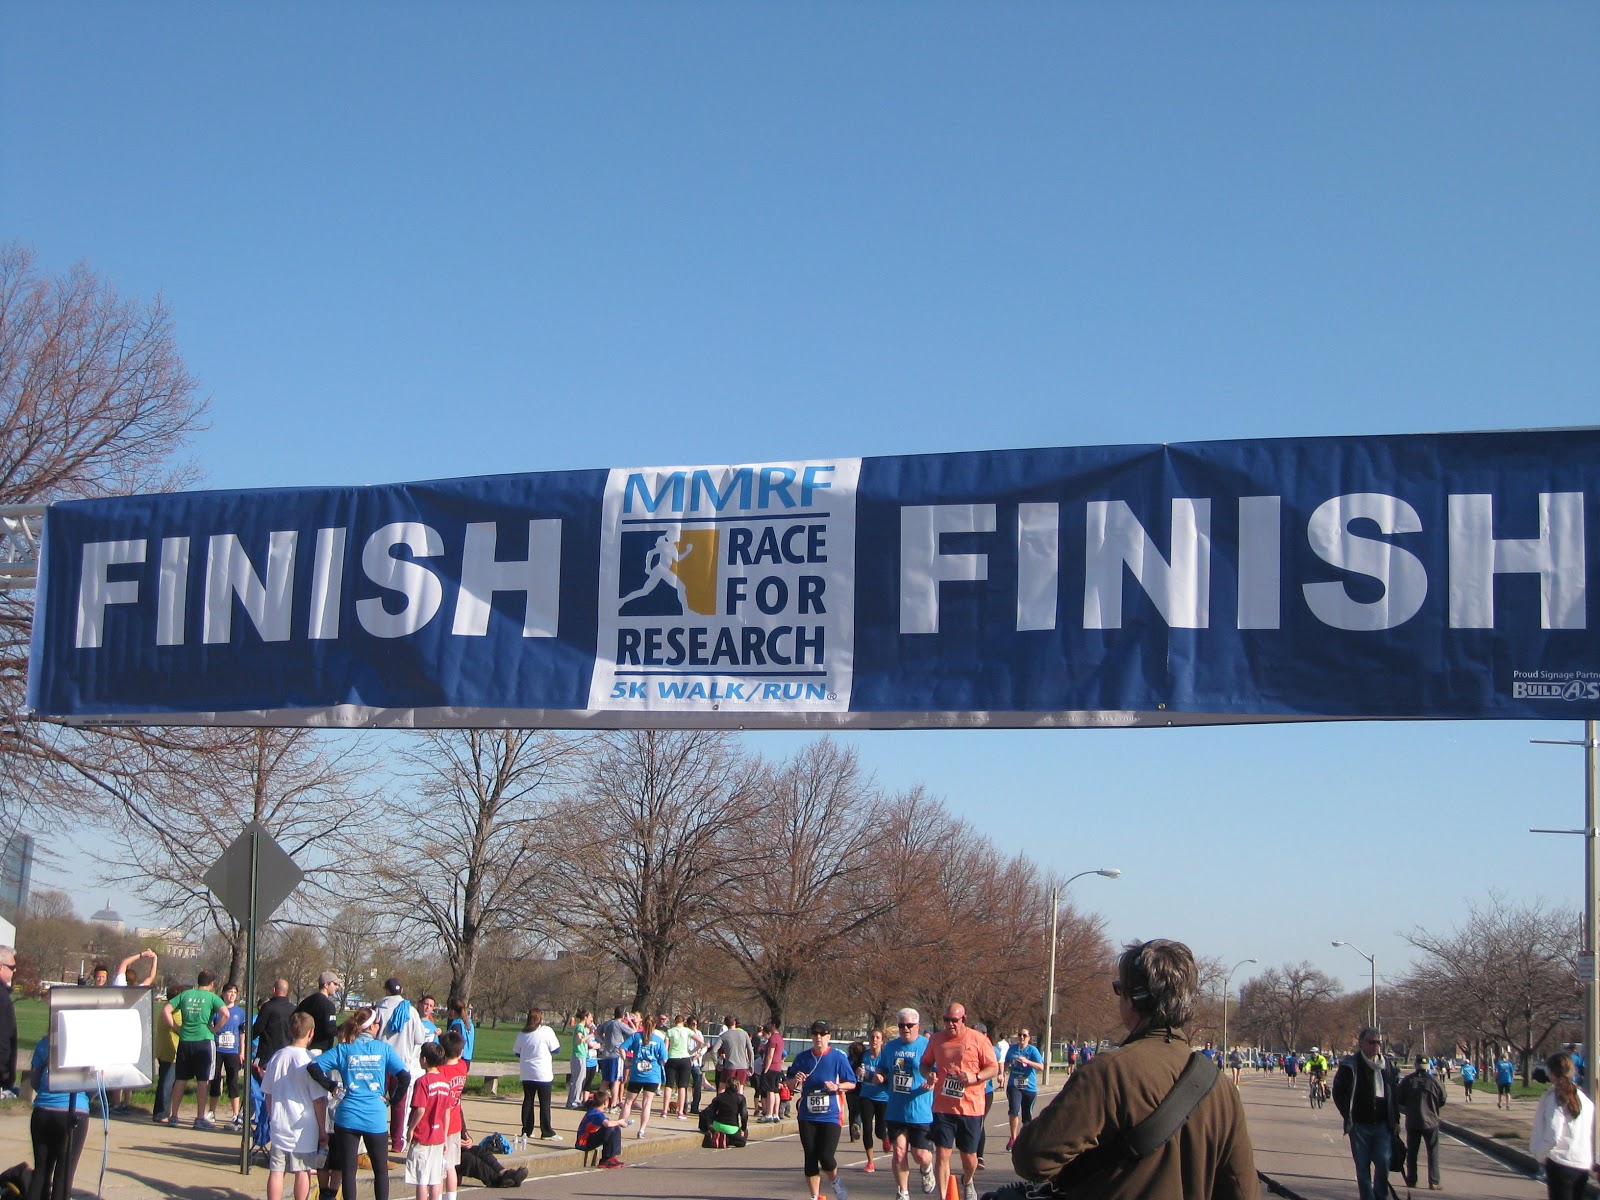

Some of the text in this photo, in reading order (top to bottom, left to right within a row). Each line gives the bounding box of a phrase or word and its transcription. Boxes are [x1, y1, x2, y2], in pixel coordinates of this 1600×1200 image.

[623, 465, 836, 514] MMRF
[727, 524, 828, 566] RACE
[900, 492, 1587, 634] FINISH
[75, 518, 563, 649] FINISH
[726, 575, 827, 616] FOR
[615, 625, 825, 666] RESEARCH
[610, 681, 648, 699] 5K
[1513, 670, 1539, 679] Proud
[1540, 670, 1575, 681] Signage
[810, 1096, 825, 1106] 561
